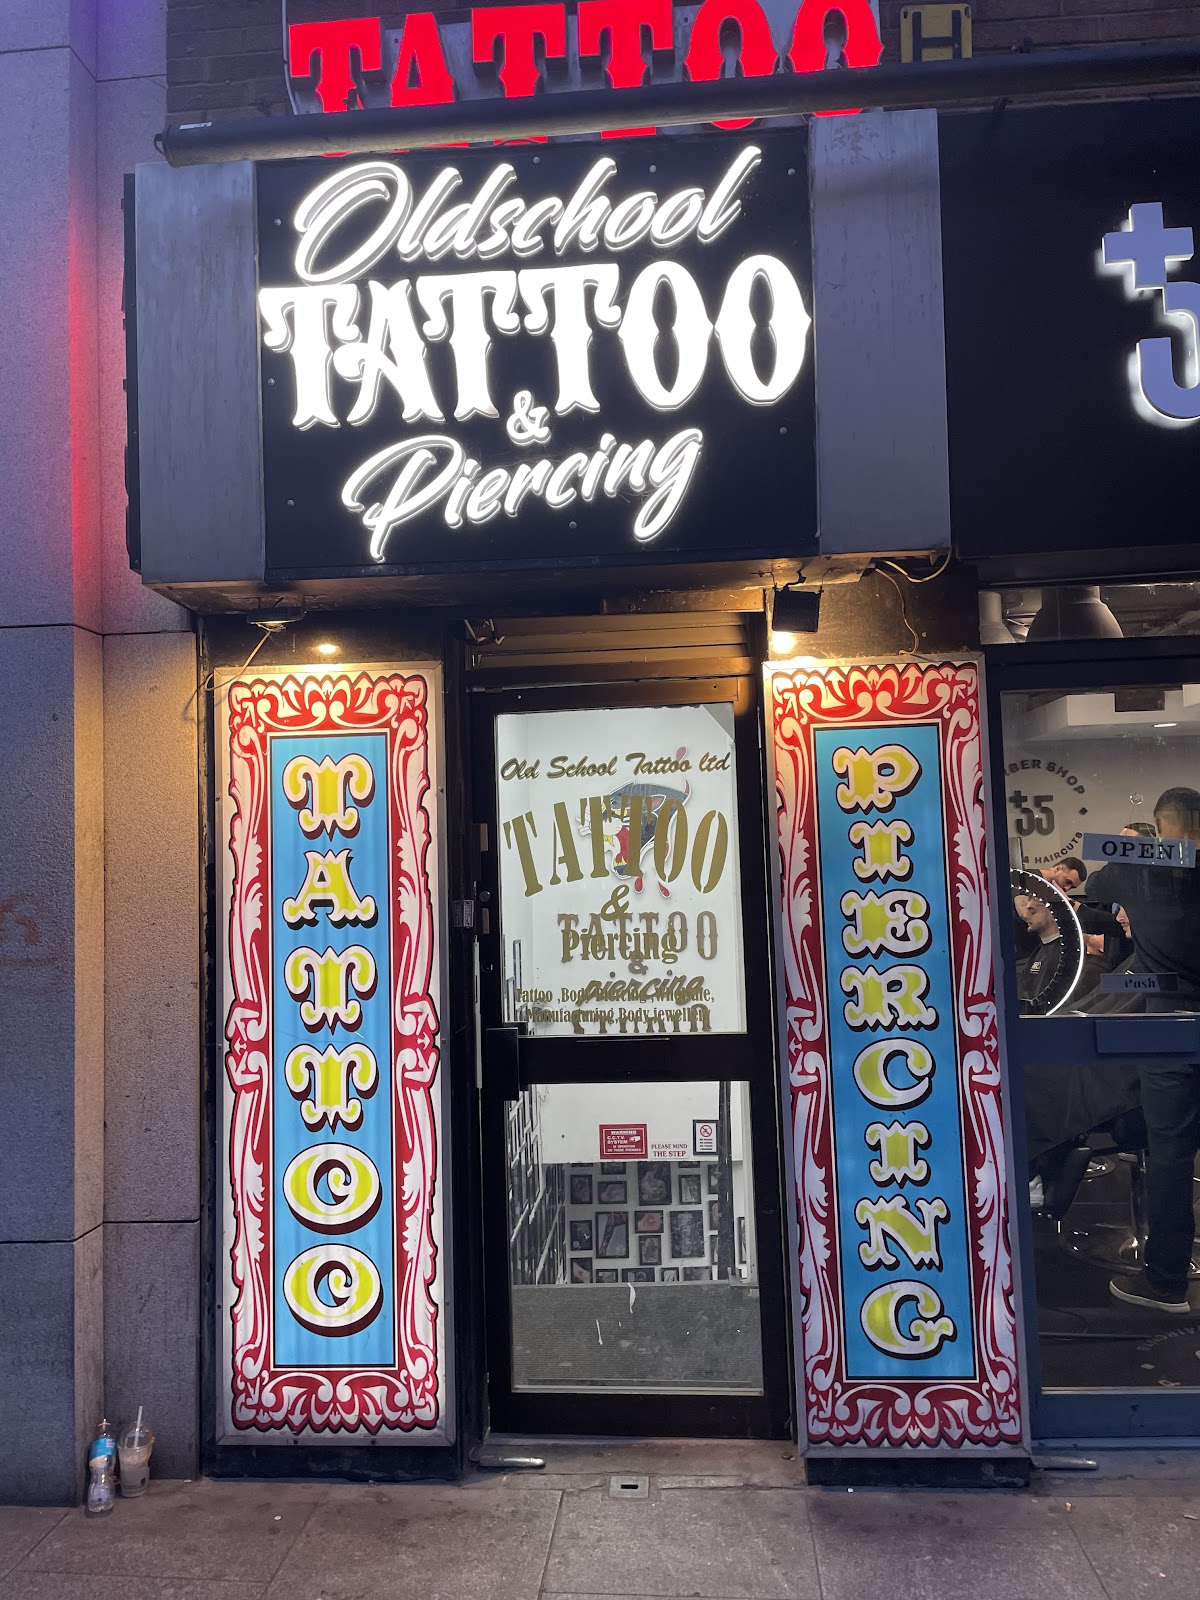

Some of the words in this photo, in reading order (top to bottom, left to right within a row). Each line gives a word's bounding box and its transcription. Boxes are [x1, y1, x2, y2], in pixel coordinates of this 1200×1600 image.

[289, 0, 884, 157] TATTOO
[293, 145, 763, 285] Oldschool
[258, 254, 812, 430] TATTOO
[506, 390, 552, 446] &
[340, 427, 705, 564] Piercing
[500, 757, 541, 781] Old
[546, 755, 618, 779] School
[625, 752, 693, 776] Tattoo
[698, 751, 731, 772] ltd
[1046, 761, 1086, 795] SHOP
[502, 794, 729, 897] TATTOO
[1034, 831, 1083, 864] HAIRCUTS
[1101, 840, 1175, 861] OPEN
[600, 884, 630, 921] &
[557, 910, 718, 960] TATTOO
[561, 927, 678, 964] Piercing
[1124, 978, 1156, 989] Push
[282, 753, 383, 1338] TATTOO
[832, 743, 957, 1360] PIERCING
